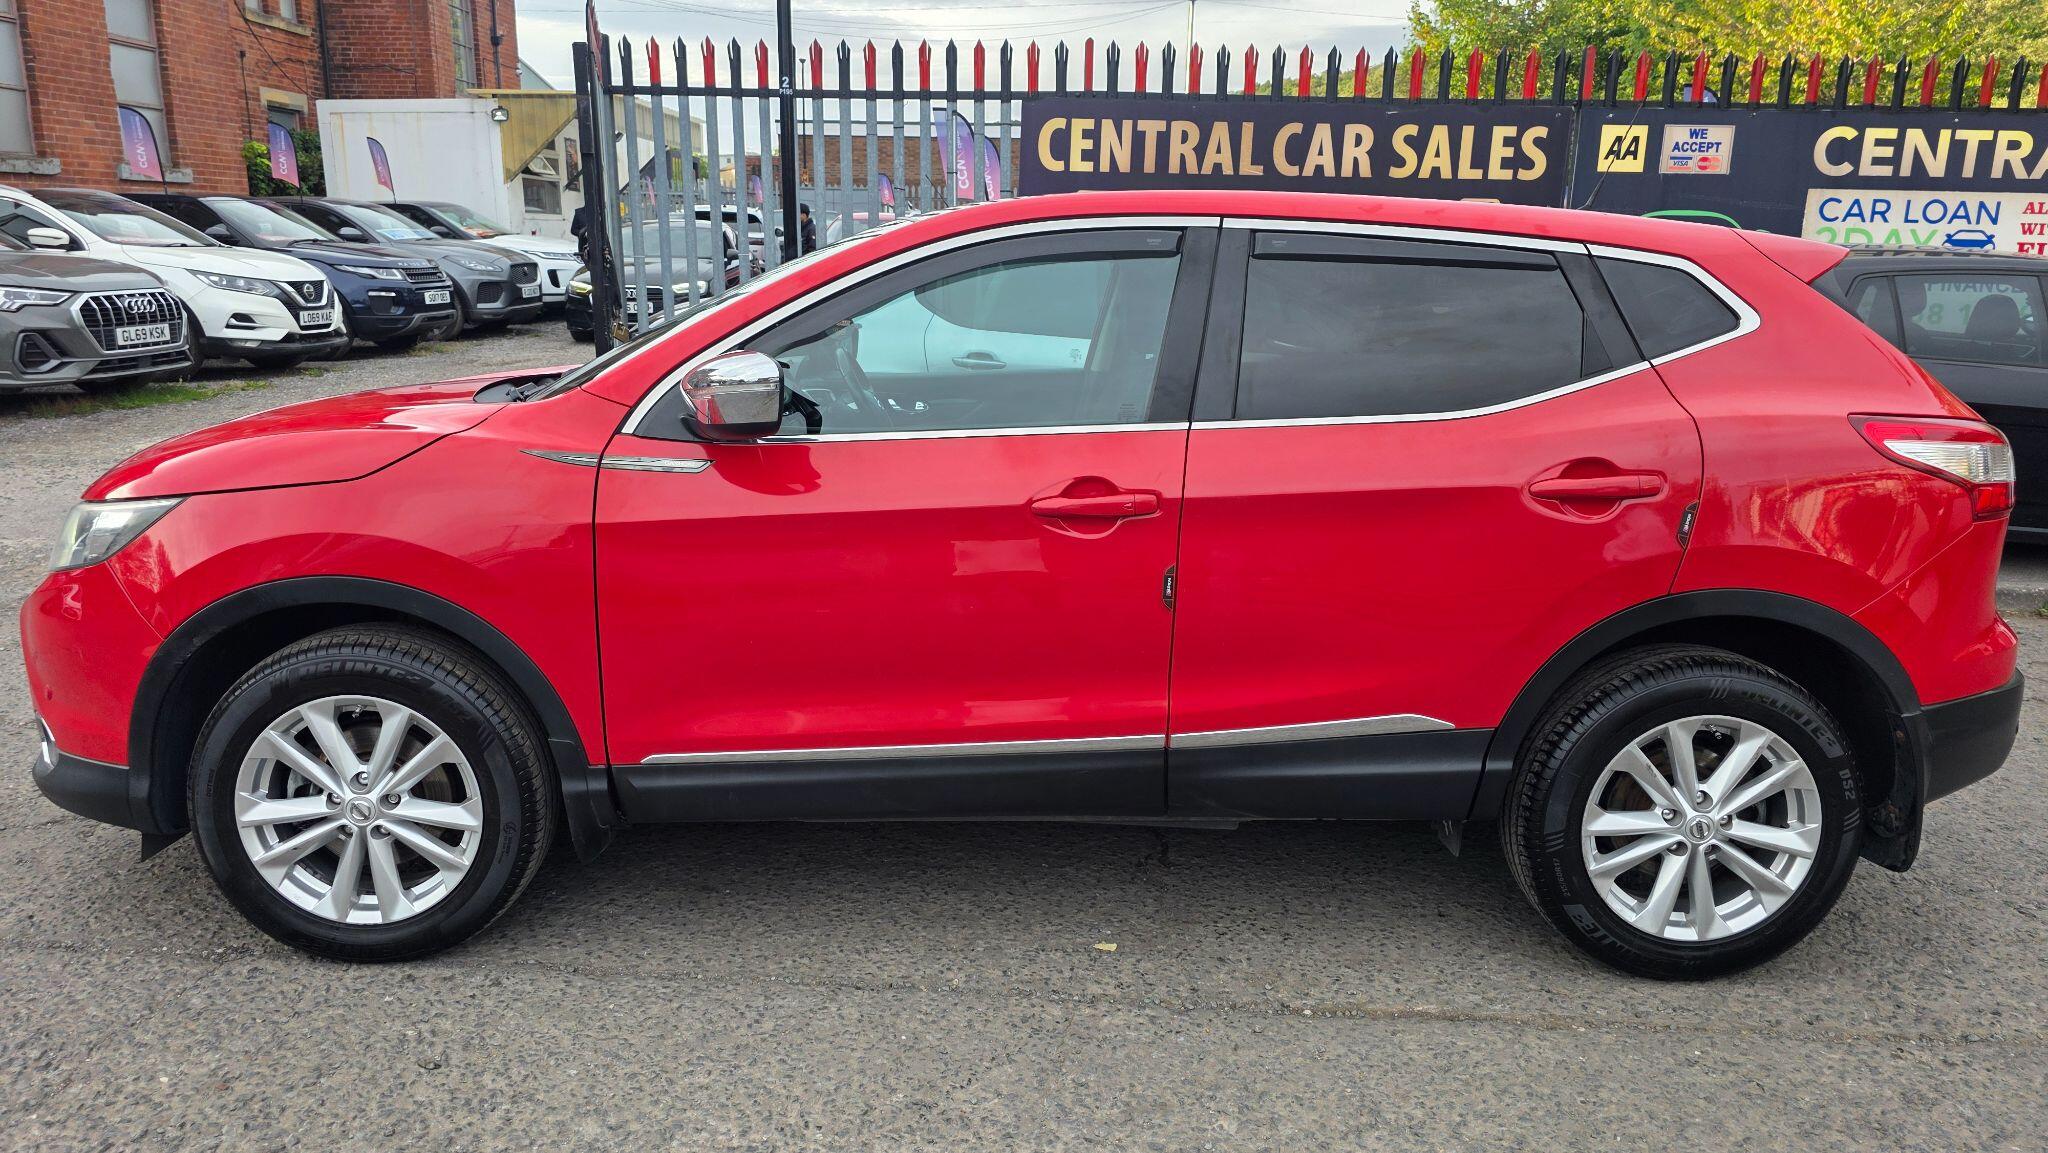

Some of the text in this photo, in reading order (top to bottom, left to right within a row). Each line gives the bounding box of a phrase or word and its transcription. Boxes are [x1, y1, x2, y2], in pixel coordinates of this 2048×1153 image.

[781, 76, 790, 88] 2
[1689, 128, 1709, 140] WE
[1037, 117, 1550, 181] CENTRAL CAR SALES
[1603, 135, 1641, 161] AA
[1671, 141, 1722, 153] ACCEPT
[1818, 197, 2002, 226] CAR LOAN
[303, 311, 333, 325] LO69 KAE
[122, 326, 167, 343] GL69 KSK
